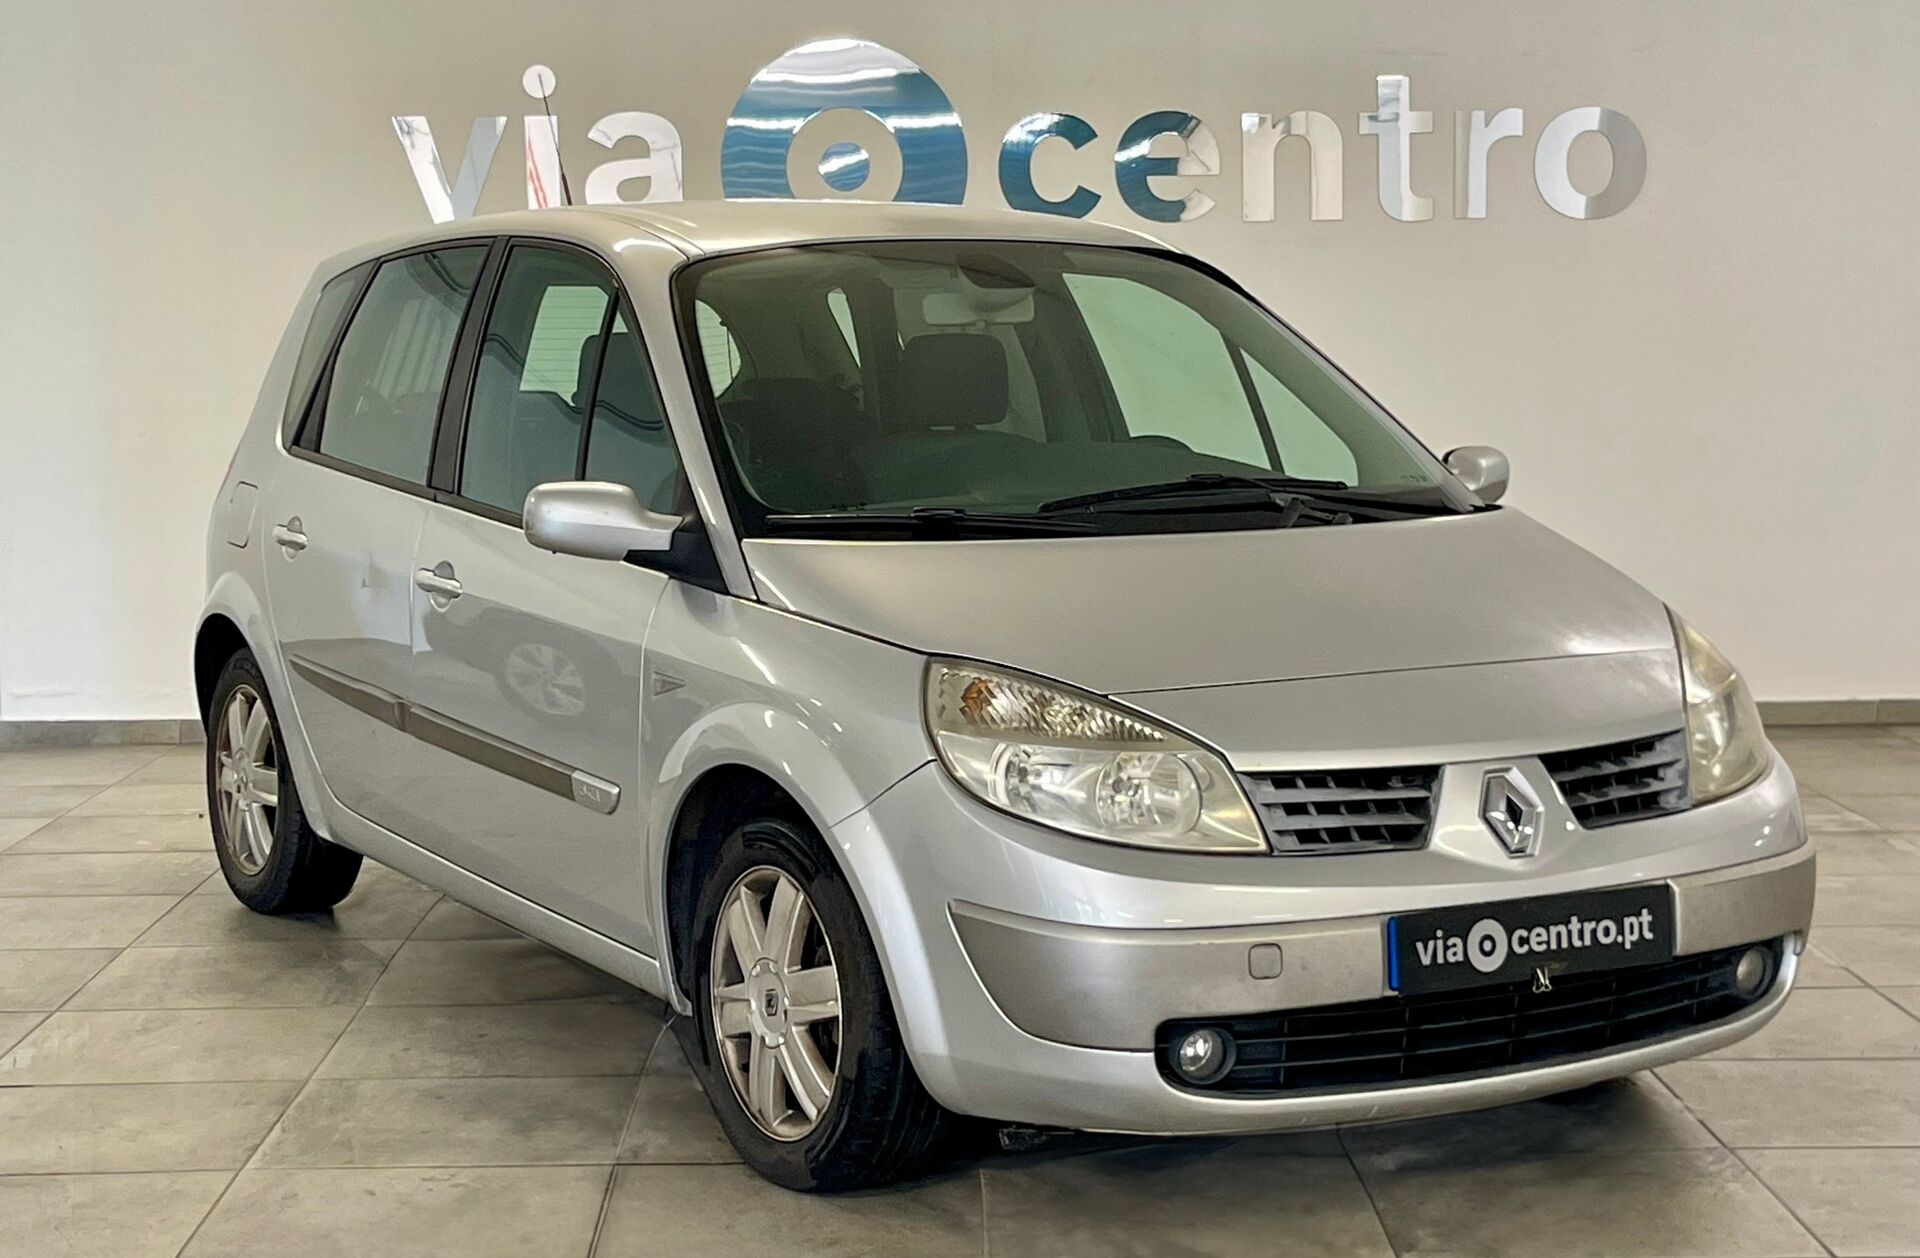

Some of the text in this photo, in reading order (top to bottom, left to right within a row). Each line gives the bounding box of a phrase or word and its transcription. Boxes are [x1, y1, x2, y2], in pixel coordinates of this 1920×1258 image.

[392, 64, 1647, 223] via centro
[1416, 908, 1653, 966] via centro.pt
